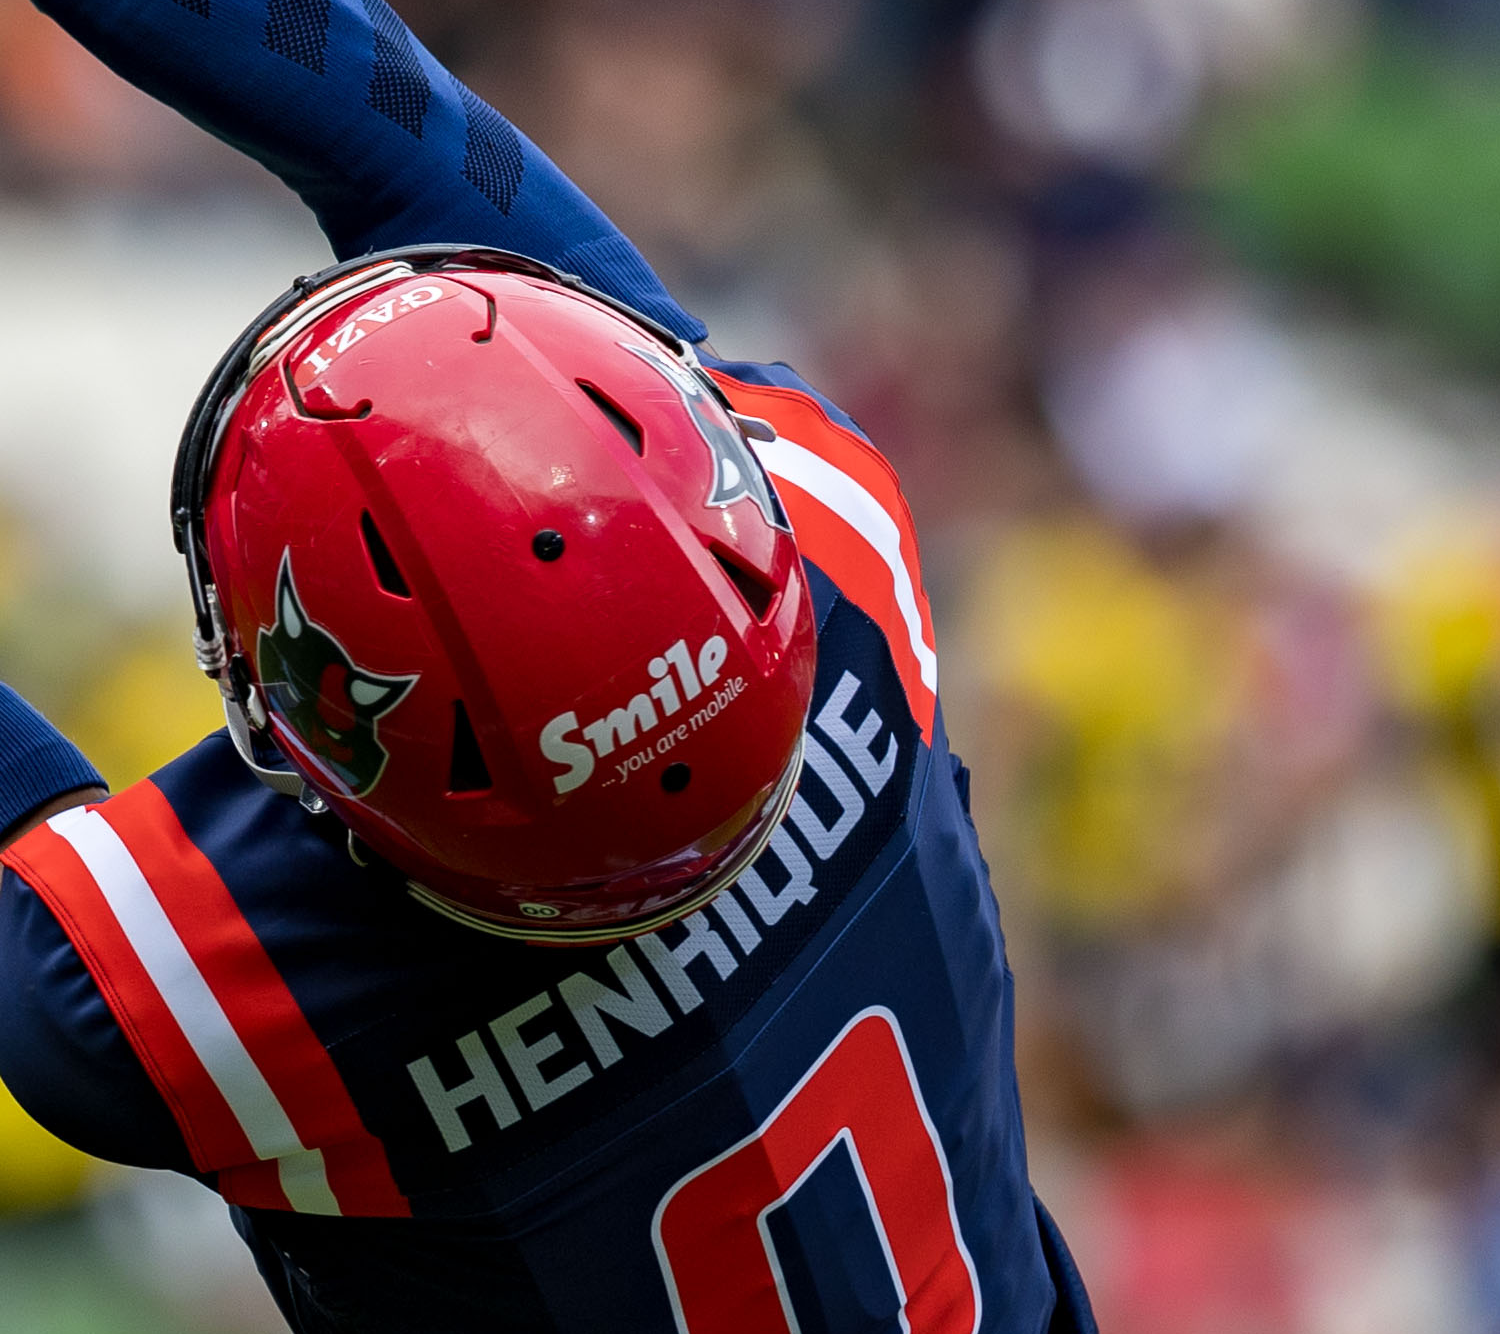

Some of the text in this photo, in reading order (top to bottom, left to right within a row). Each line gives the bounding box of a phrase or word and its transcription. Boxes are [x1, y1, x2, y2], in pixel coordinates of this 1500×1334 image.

[302, 285, 444, 375] GAZI
[539, 634, 728, 795] Smile
[656, 723, 689, 754] are
[688, 676, 749, 731] mobile.
[406, 669, 900, 1153] HENRIQUE
